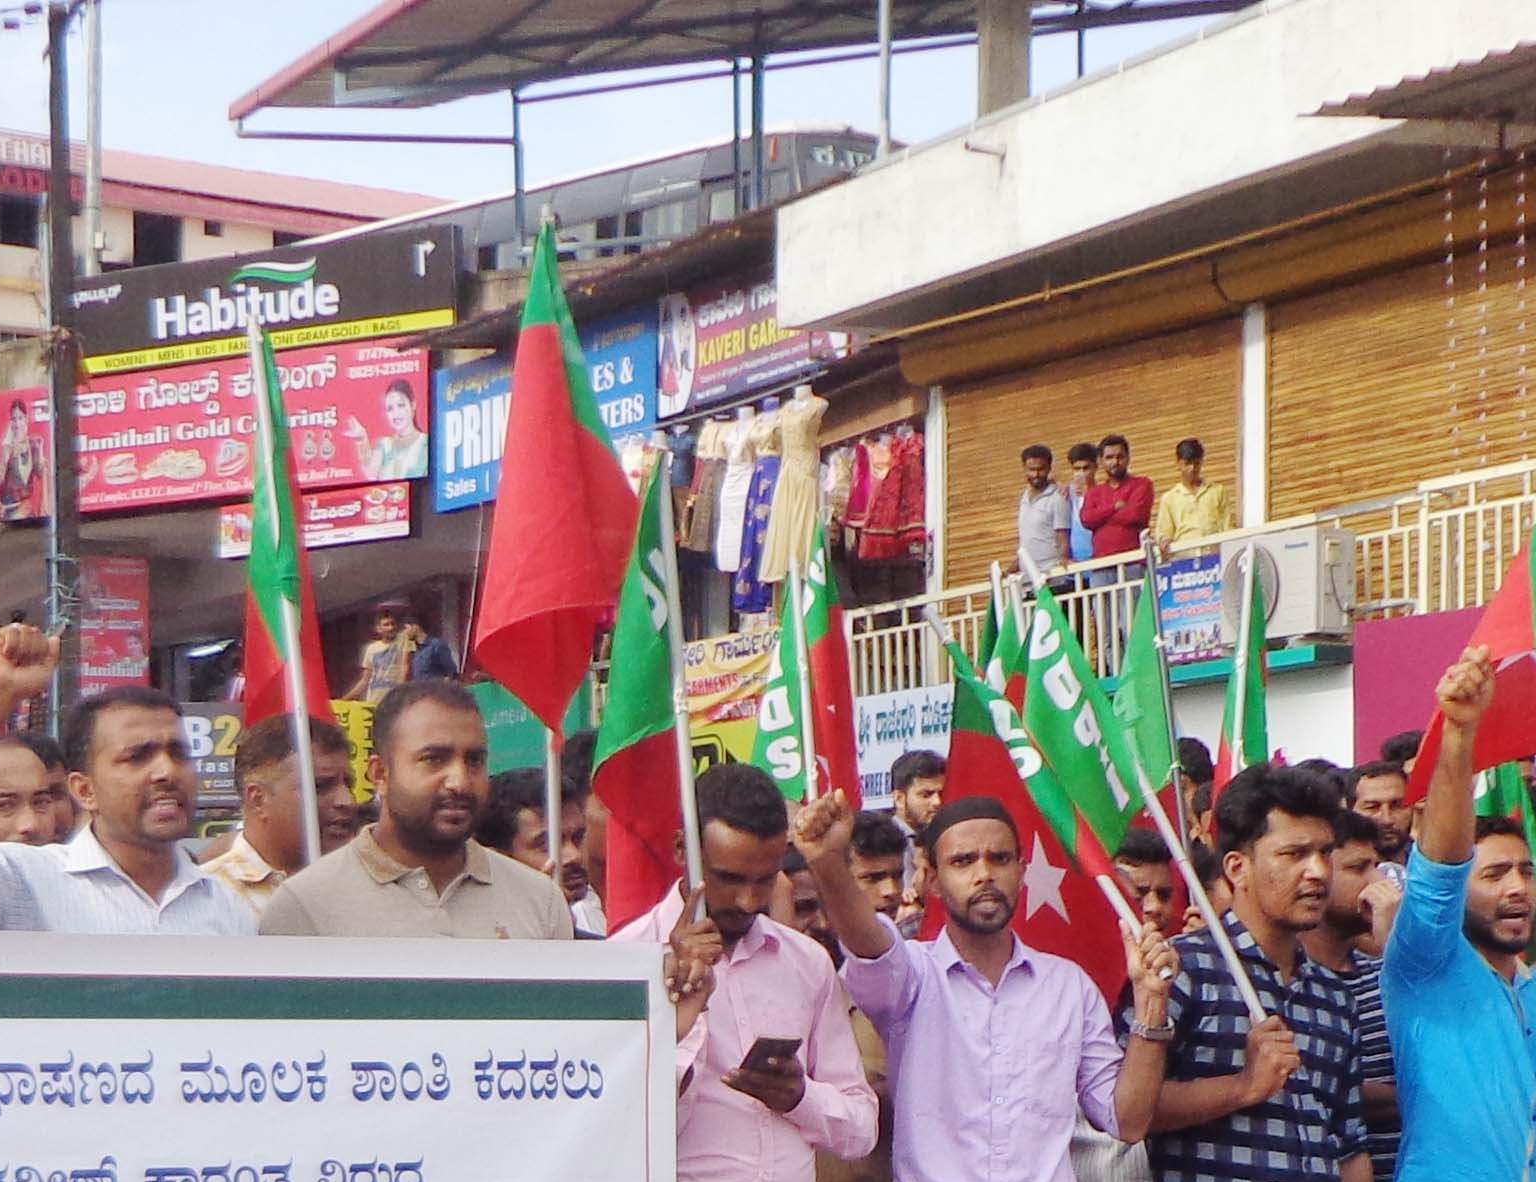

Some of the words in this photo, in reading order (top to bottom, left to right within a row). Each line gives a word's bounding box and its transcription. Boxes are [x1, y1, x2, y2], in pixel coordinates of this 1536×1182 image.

[152, 278, 340, 339] Habitude
[228, 339, 252, 352] FAN
[698, 327, 745, 368] KAVERI
[79, 426, 170, 452] anithali
[176, 416, 231, 442] Gold
[444, 391, 513, 475] PRIN
[444, 476, 478, 500] Sales
[180, 1047, 329, 1103] ಮೂಲಕ
[350, 1050, 452, 1102] ಶಾಂತಿ
[473, 1047, 605, 1101] ಕದಡಲು
